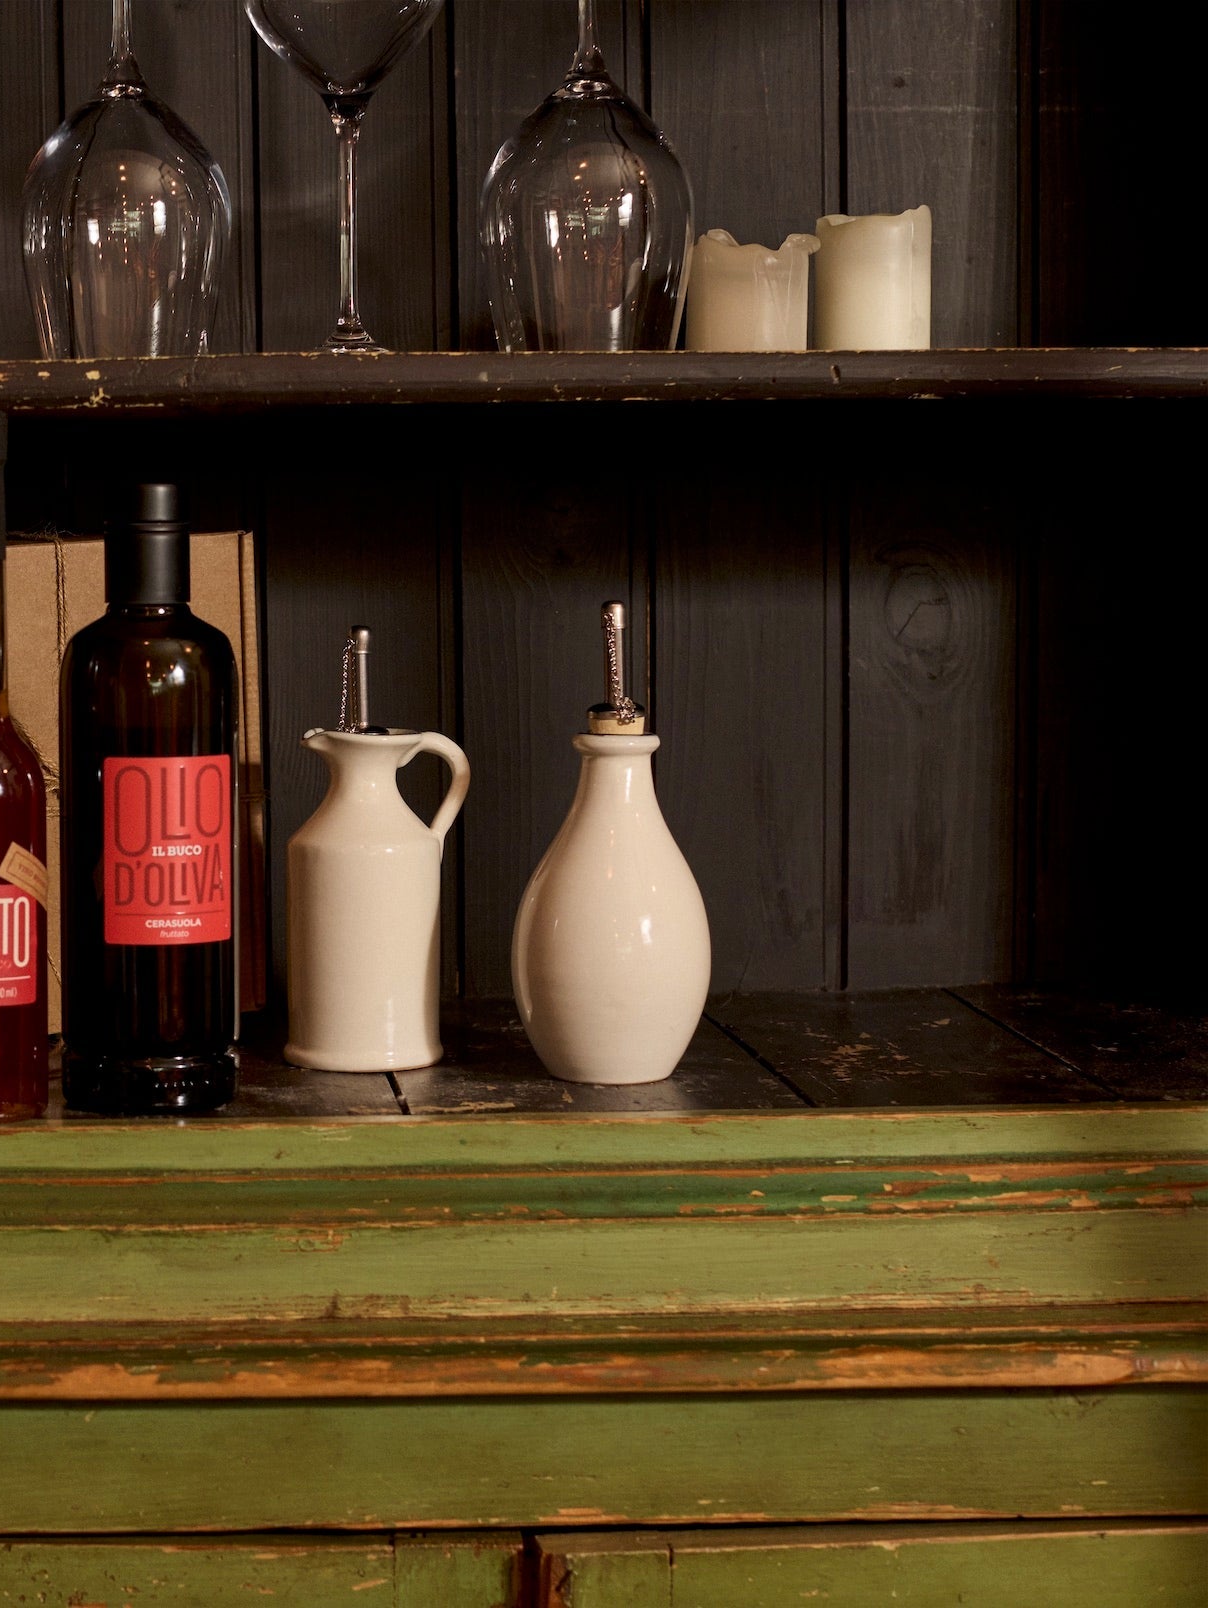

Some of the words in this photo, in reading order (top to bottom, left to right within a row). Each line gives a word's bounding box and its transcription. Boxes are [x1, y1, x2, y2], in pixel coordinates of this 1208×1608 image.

[114, 764, 223, 857] OLIO
[152, 846, 165, 856] IL
[167, 845, 202, 856] BUCO
[145, 917, 202, 928] CERASUOLA
[159, 930, 190, 938] fruttato
